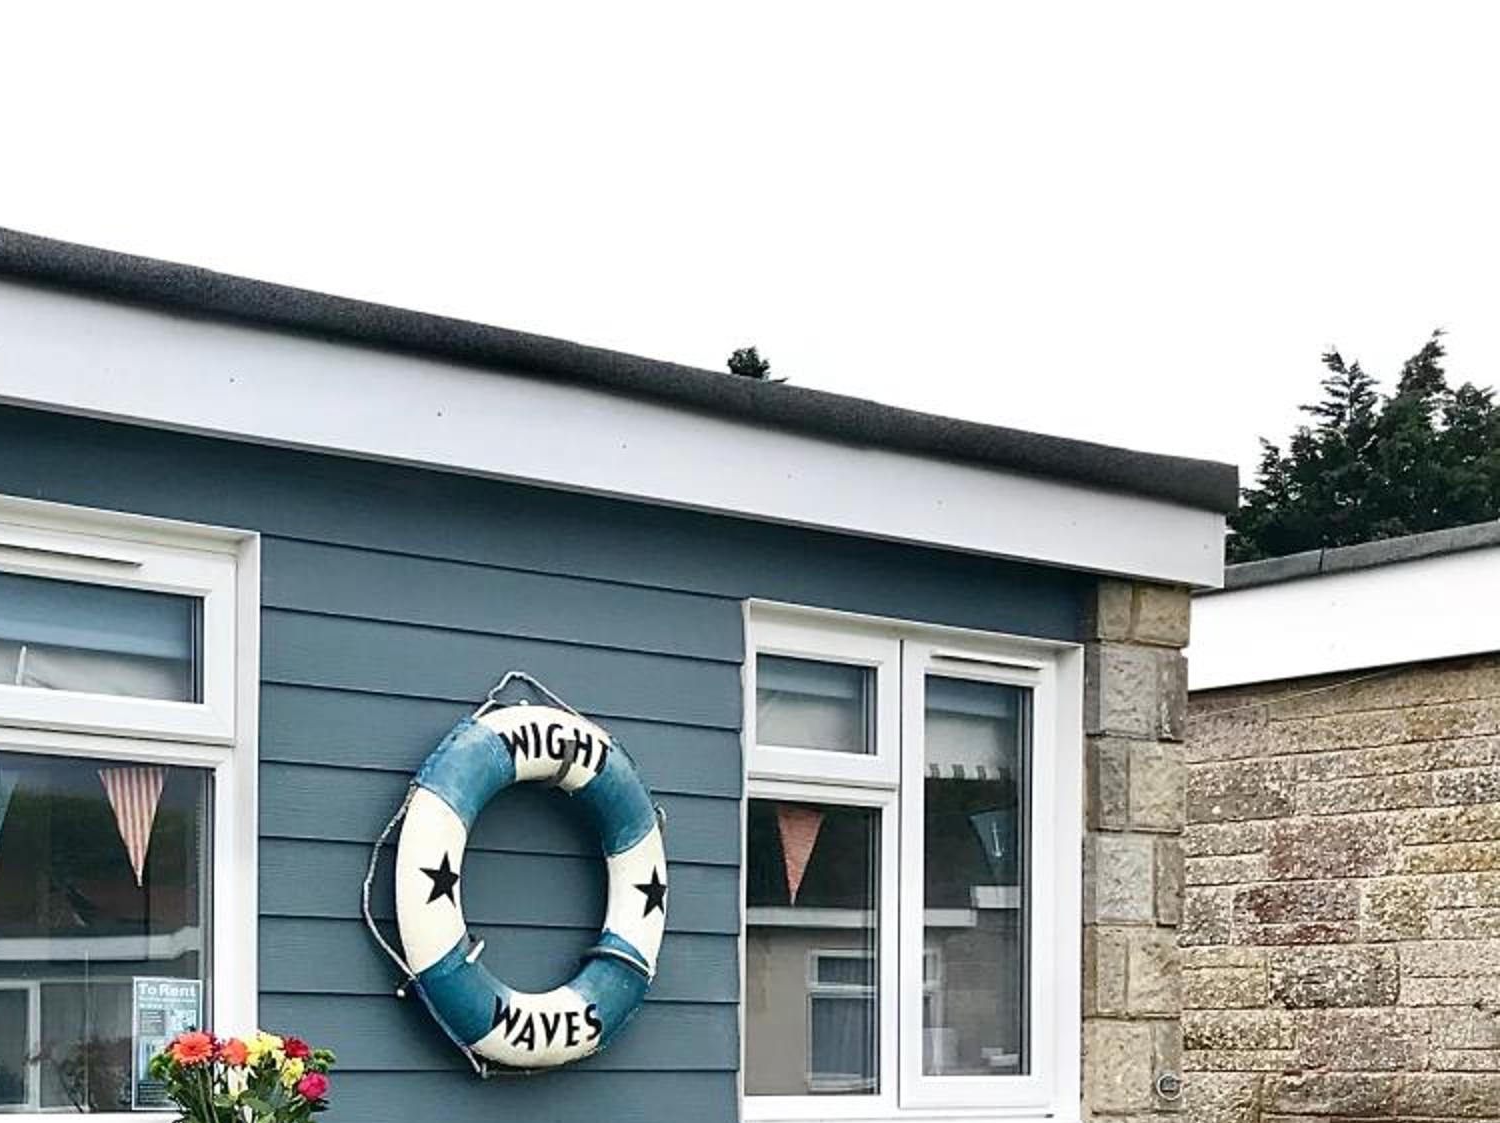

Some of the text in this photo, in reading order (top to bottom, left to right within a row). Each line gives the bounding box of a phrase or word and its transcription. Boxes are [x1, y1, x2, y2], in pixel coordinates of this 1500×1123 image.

[498, 722, 612, 775] WIGHT
[138, 983, 197, 997] To Rent
[494, 995, 602, 1051] WAVES
